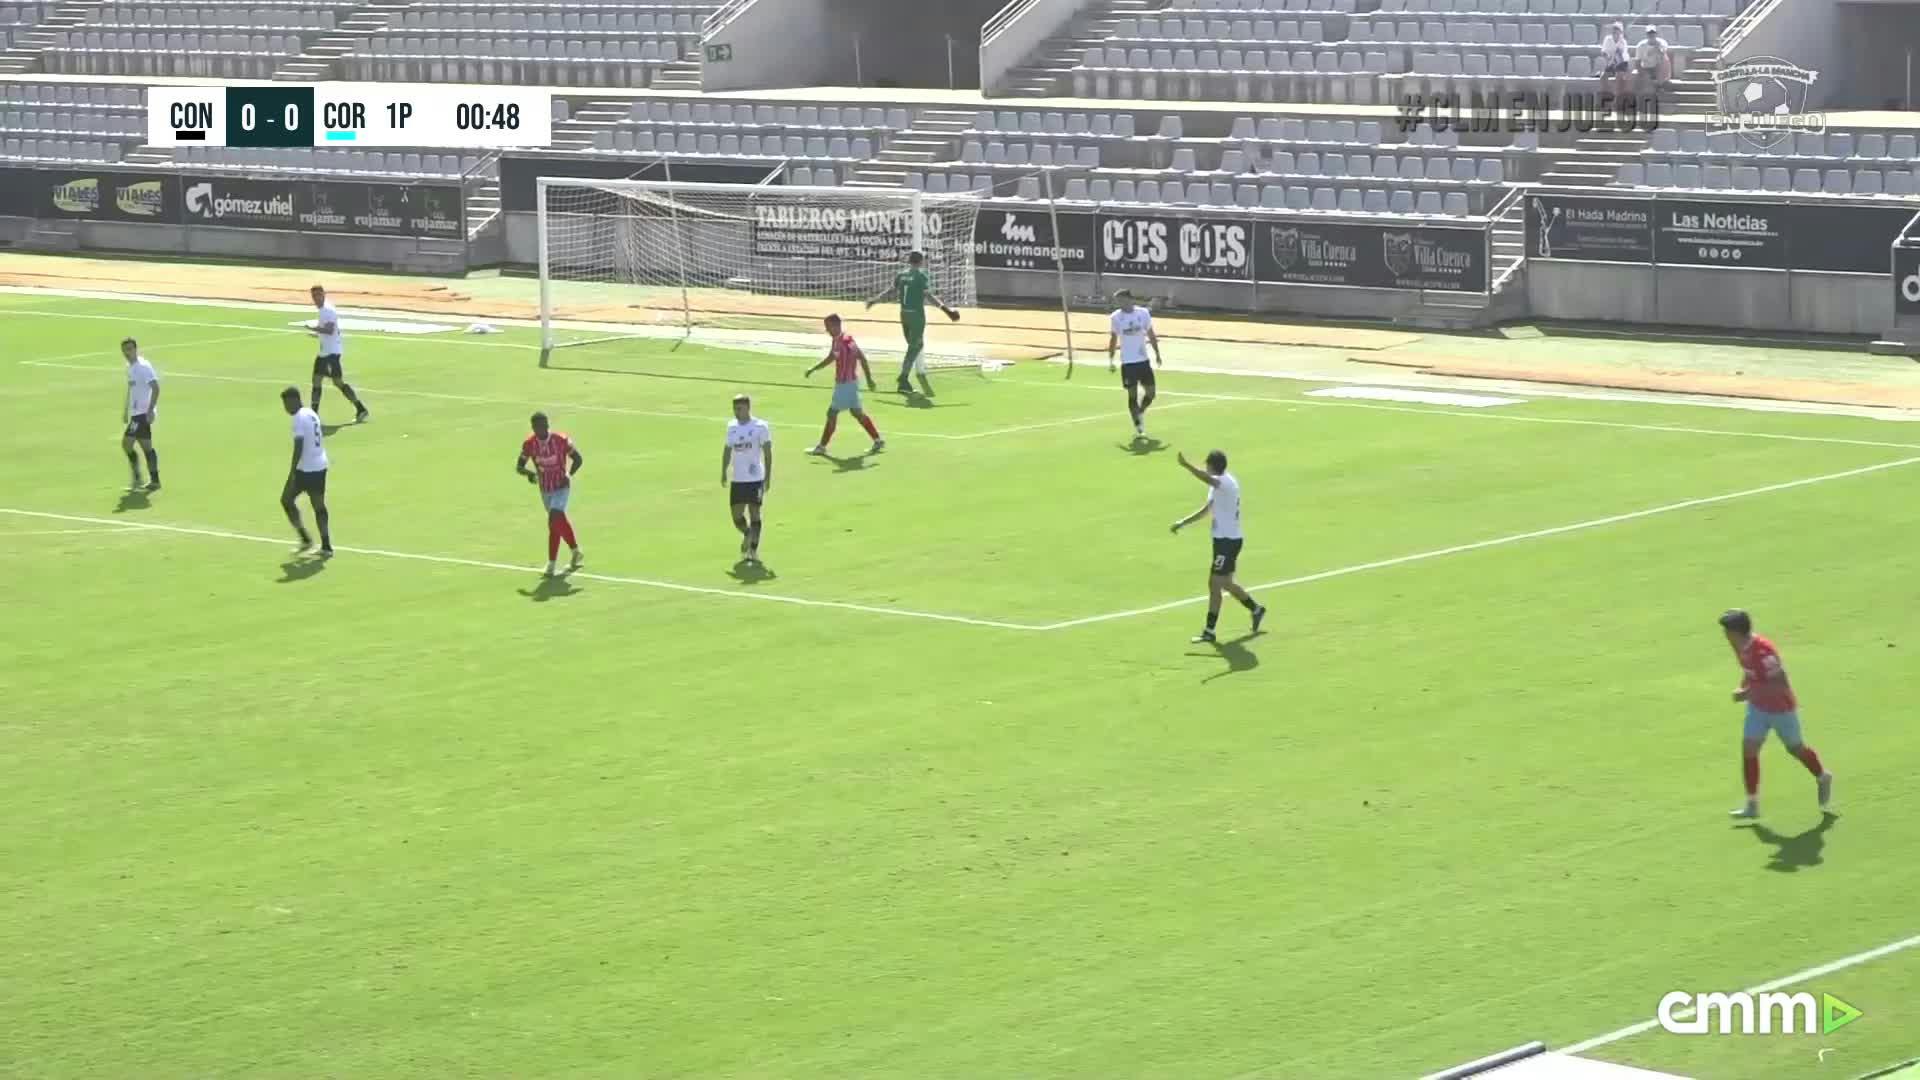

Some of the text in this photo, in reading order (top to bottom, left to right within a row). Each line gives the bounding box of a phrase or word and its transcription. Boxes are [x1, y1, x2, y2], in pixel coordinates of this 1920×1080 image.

[215, 193, 293, 217] gómez utiel
[354, 213, 402, 228] rujamar
[411, 217, 458, 231] rujamar
[755, 205, 942, 234] TABLEROS MONTERO
[1566, 208, 1647, 222] El Hada Madrina
[1672, 211, 1768, 230] Las Noticias
[954, 240, 987, 254] hotel
[990, 242, 1085, 260] torremangana
[1103, 219, 1246, 267] COES COES
